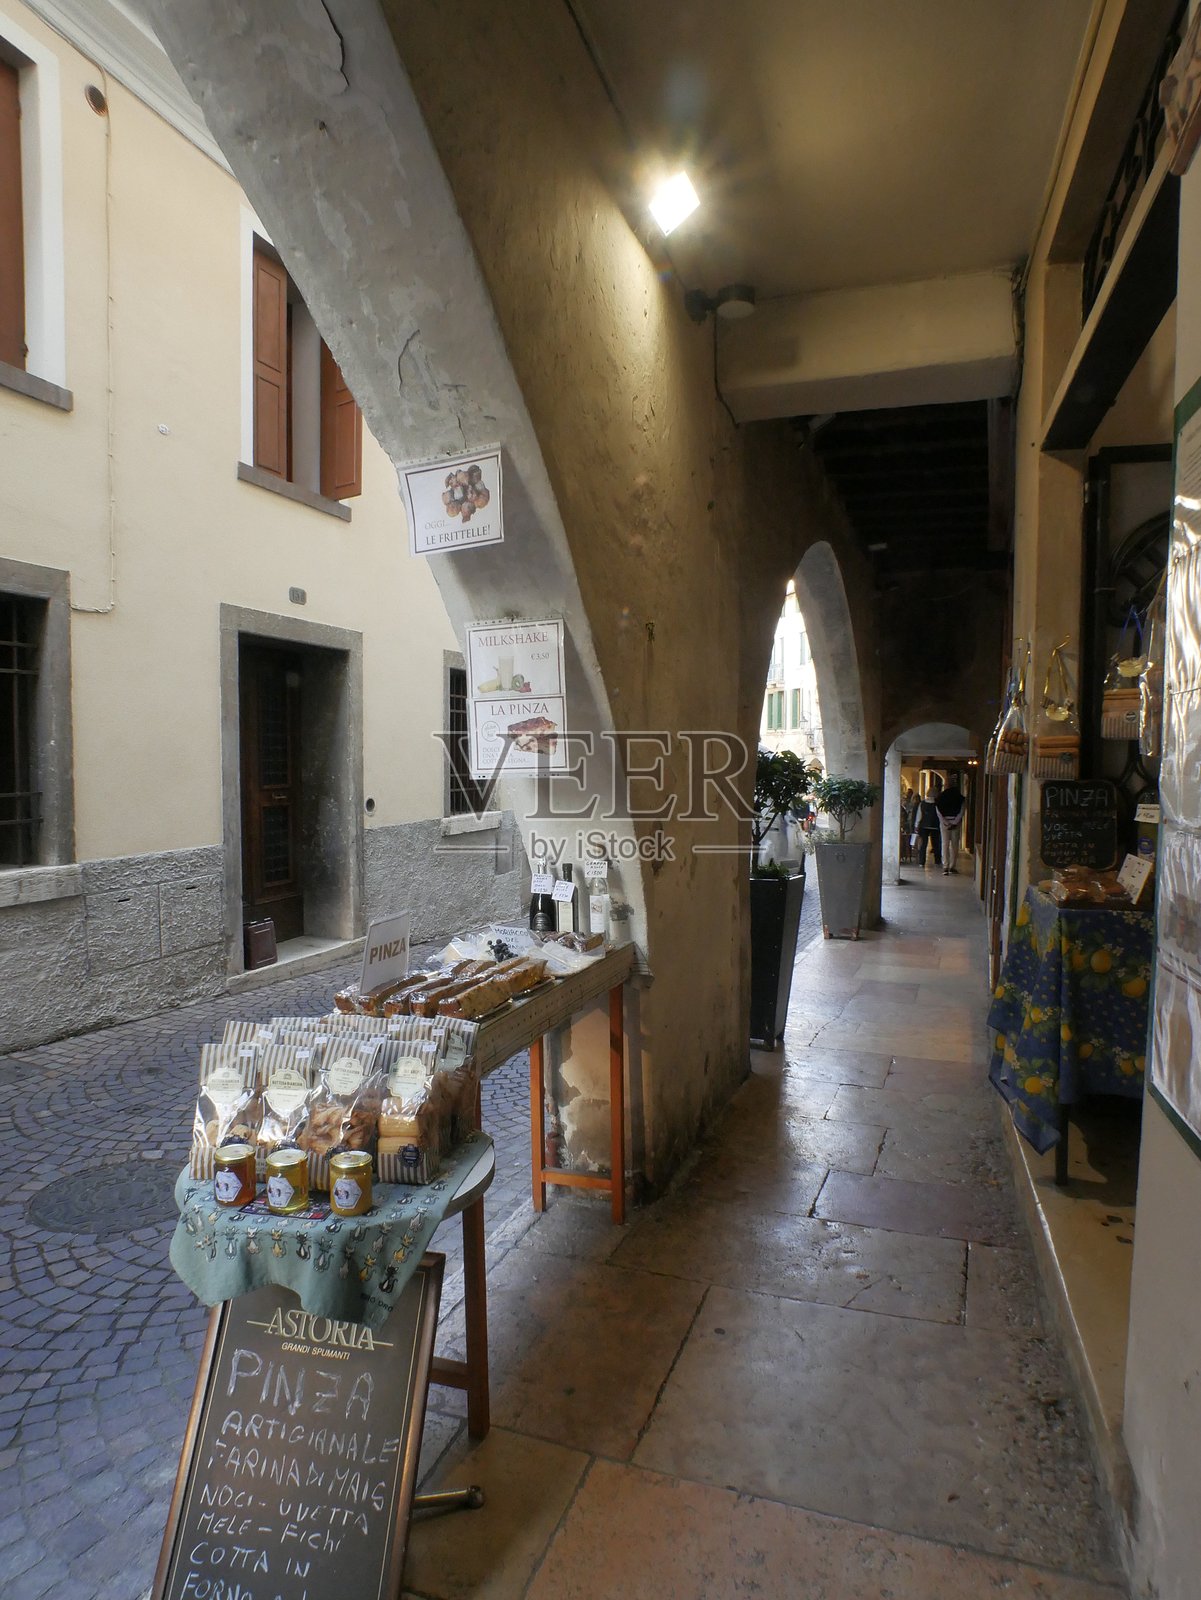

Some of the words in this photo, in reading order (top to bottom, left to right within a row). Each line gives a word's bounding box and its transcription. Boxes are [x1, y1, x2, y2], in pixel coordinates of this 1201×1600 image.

[426, 536, 436, 546] LE
[440, 525, 491, 543] FRITTELLE!
[478, 632, 549, 647] MILKSHAKE
[491, 705, 505, 716] LA
[510, 703, 549, 715] PINZA
[1045, 786, 1109, 808] PINZA
[369, 938, 406, 965] PINZA
[264, 1307, 375, 1350] ASTORIA
[281, 1342, 310, 1354] GRANDI
[312, 1347, 350, 1360] SPUMANTI
[226, 1348, 375, 1421] PINZA
[222, 1410, 400, 1463] ARTIGIANALE
[328, 1467, 386, 1511] MAIS
[197, 1512, 252, 1536] MELE
[279, 1497, 368, 1535] UVETTA
[189, 1541, 269, 1573] COTTA
[285, 1557, 311, 1578] IN
